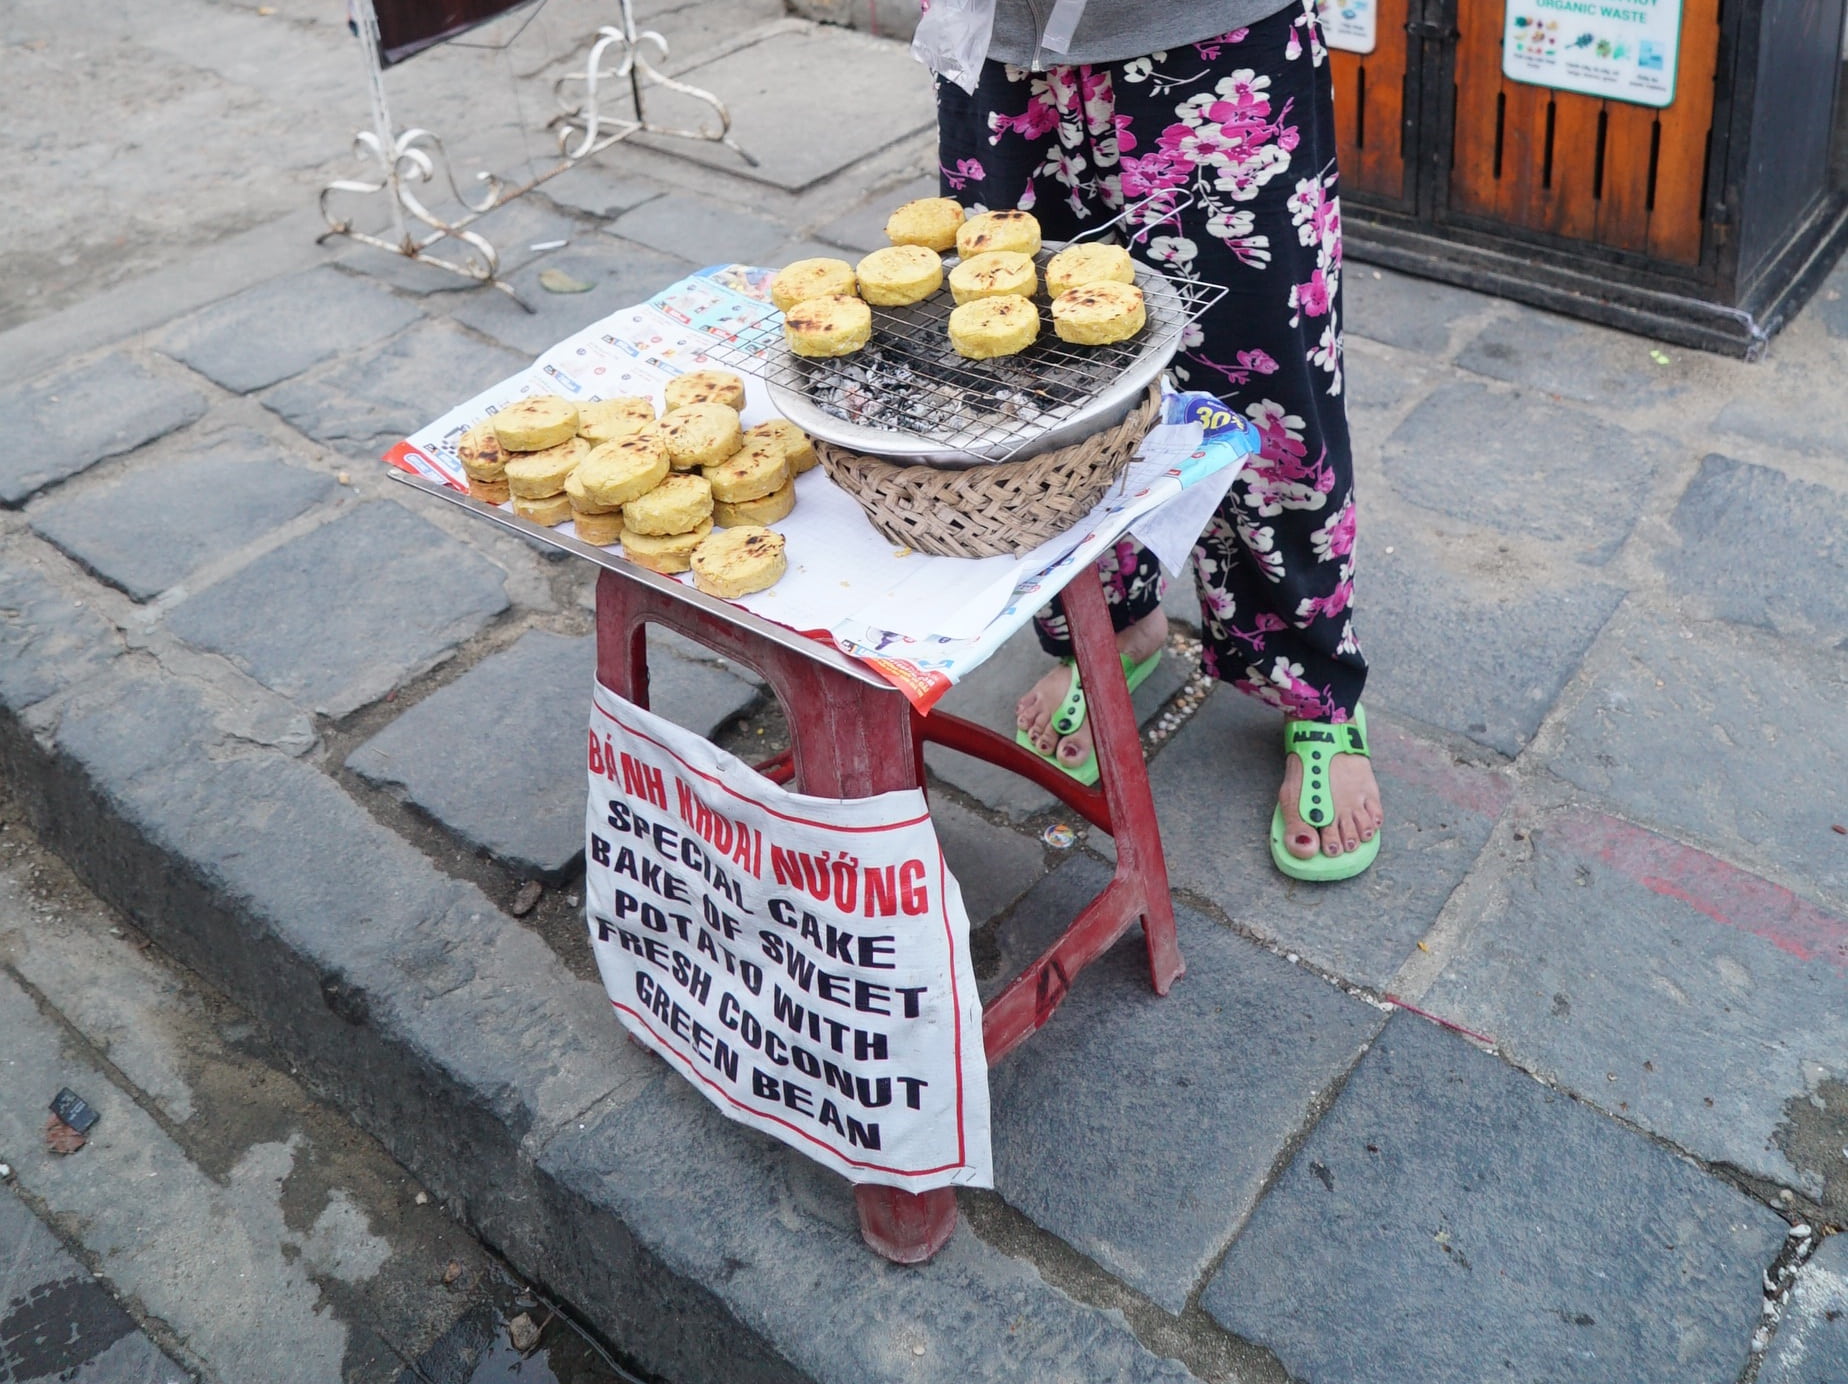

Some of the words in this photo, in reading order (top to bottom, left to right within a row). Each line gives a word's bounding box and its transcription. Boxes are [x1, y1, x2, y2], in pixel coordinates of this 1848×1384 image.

[1600, 5, 1648, 24] WASTE
[589, 728, 668, 812] BÁNH
[675, 776, 762, 880] KHOAI
[770, 843, 929, 918] NƯỚNG
[607, 799, 754, 915] SPECIAL
[767, 898, 896, 969] CAKE
[591, 832, 692, 906] BAKE
[702, 893, 742, 941] OF
[758, 930, 928, 1018] SWEET
[595, 916, 712, 1007] FRESH
[718, 991, 929, 1111] COCONUT
[614, 889, 763, 996] POTATO
[773, 982, 889, 1061] WITH
[635, 970, 739, 1084] GREEN
[752, 1066, 882, 1151] BEAN
